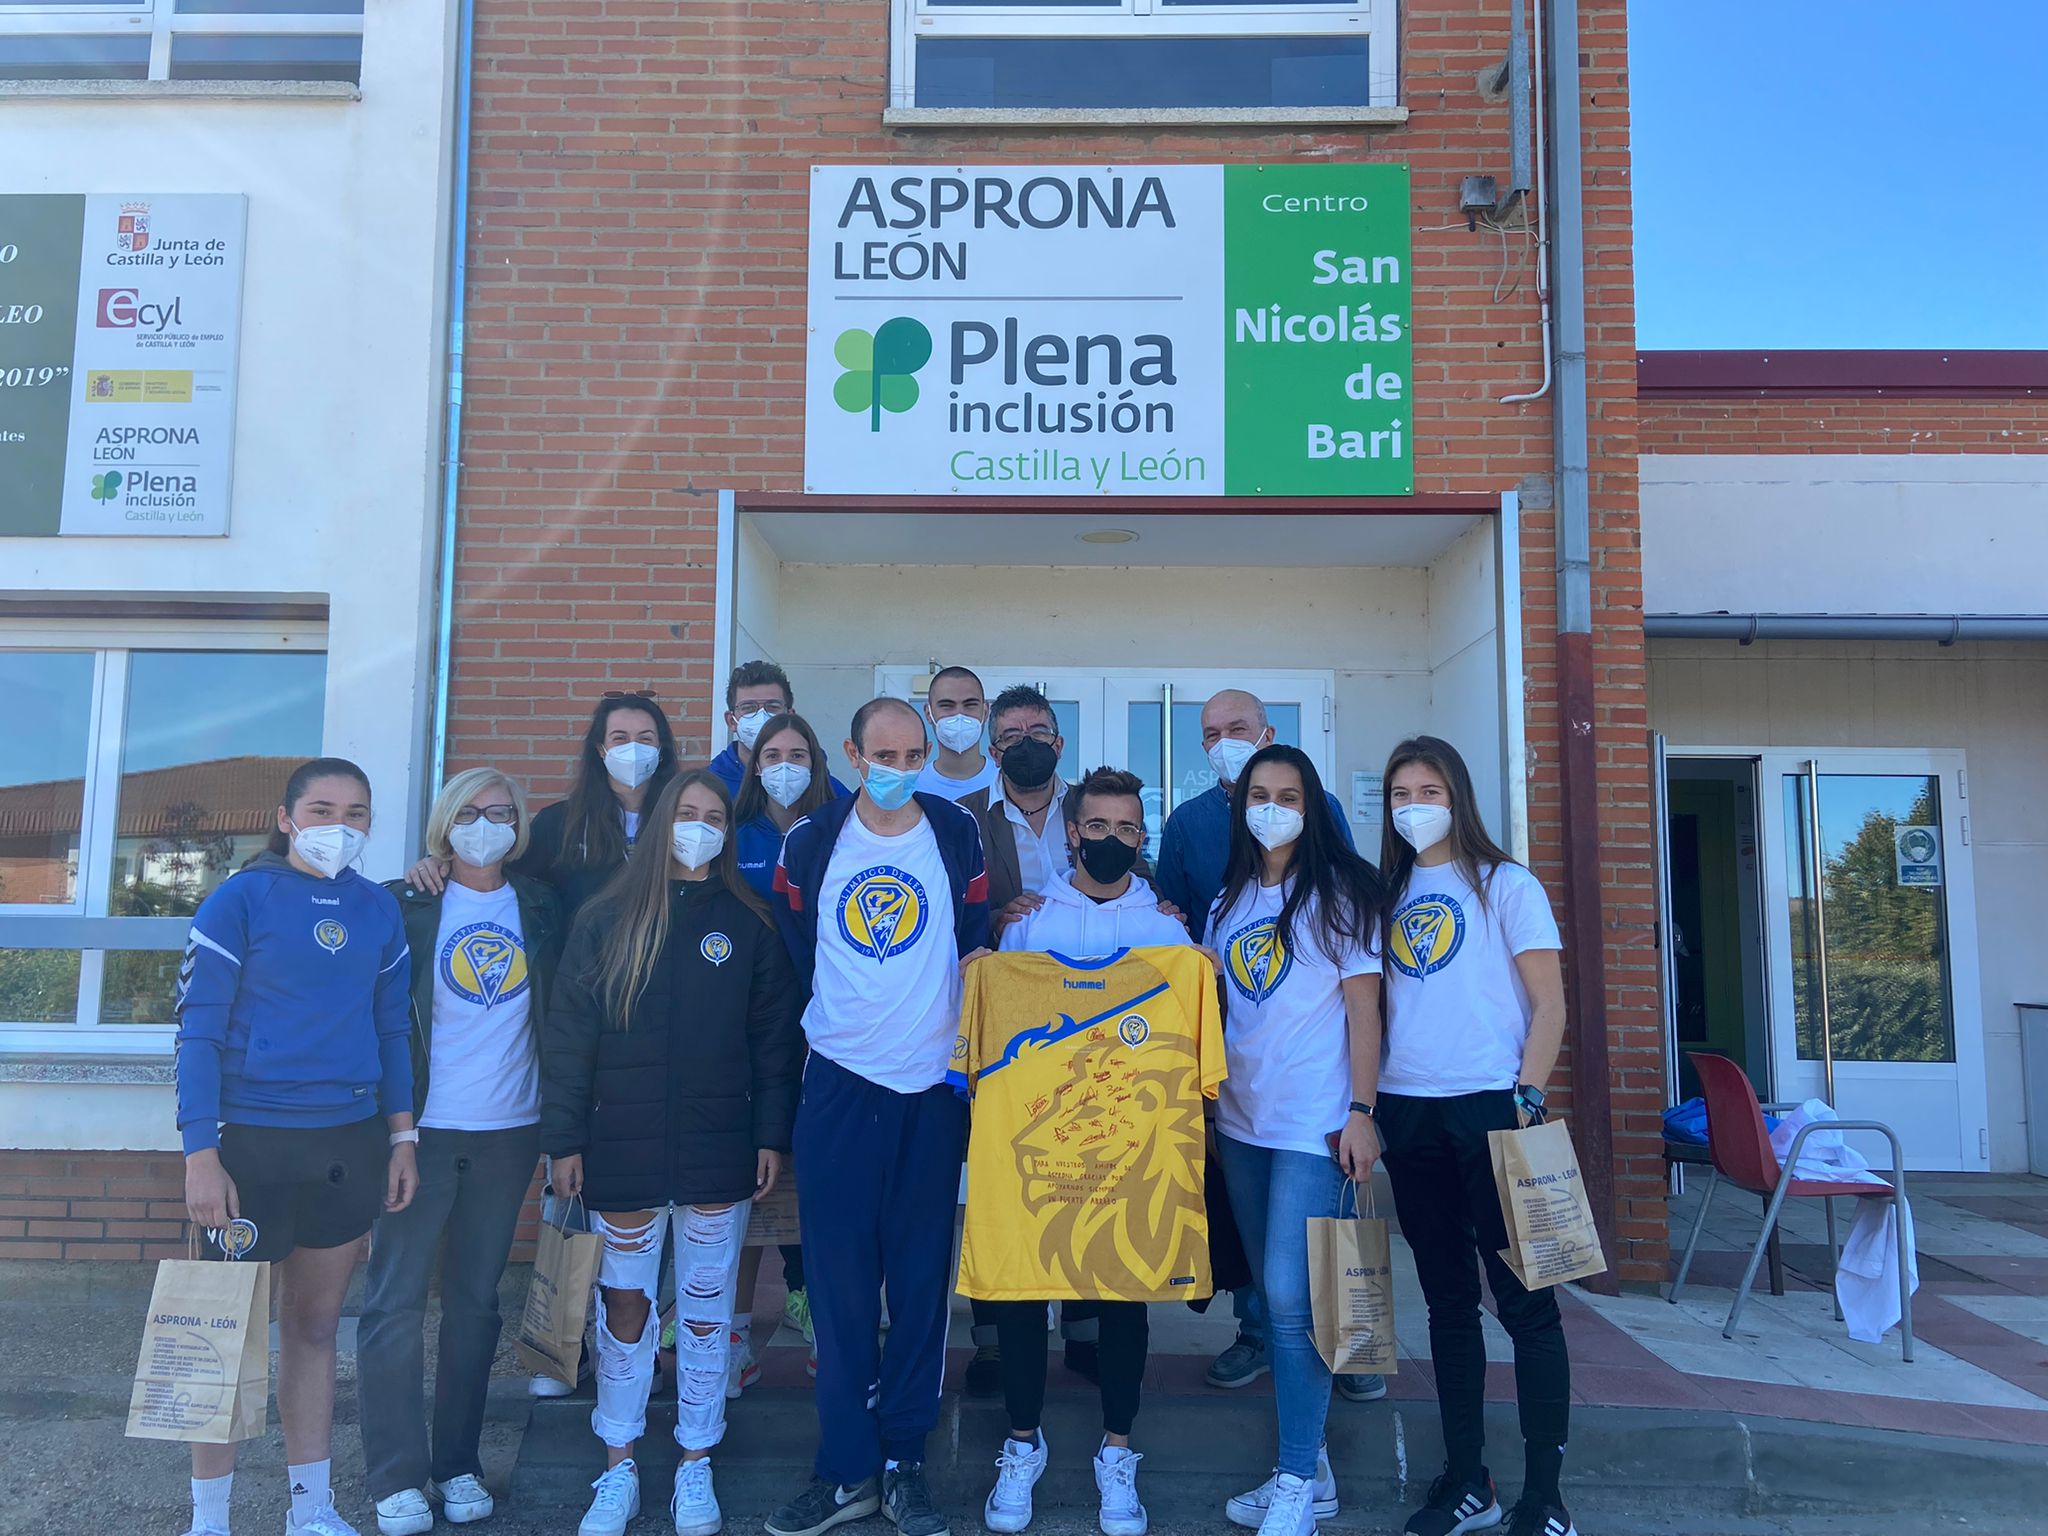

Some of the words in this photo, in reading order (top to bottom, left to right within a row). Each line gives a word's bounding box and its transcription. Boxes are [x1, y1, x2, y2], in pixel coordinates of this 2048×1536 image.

[837, 176, 1176, 229] ASPRONA
[1262, 193, 1368, 213] Centro
[153, 239, 199, 251] Junta
[205, 239, 225, 251] de
[107, 253, 164, 266] Castilla
[168, 255, 179, 269] y
[184, 253, 224, 266] León
[834, 232, 967, 281] LEÓN
[1312, 250, 1401, 284] San
[1235, 302, 1402, 343] Nicolás
[136, 333, 164, 341] SERVICIO
[165, 332, 190, 341] PÚBLICO
[179, 340, 196, 348] LEÓN
[950, 317, 1177, 386] Plena
[1345, 363, 1402, 400] de
[949, 389, 1174, 434] inclusión
[0, 430, 26, 442] tes
[95, 427, 200, 444] ASPRONA
[1307, 417, 1402, 459] Bari
[93, 444, 135, 460] LEÓN
[950, 449, 1081, 481] Castilla
[1083, 455, 1111, 489] y
[1121, 448, 1206, 481] León
[126, 470, 197, 493] Plena
[125, 493, 196, 507] inclusión
[125, 510, 166, 521] Castilla
[168, 512, 175, 523] y
[177, 510, 204, 521] León
[838, 866, 886, 909] OLIMPICO
[891, 868, 905, 880] DE
[442, 922, 489, 959] OLIMPICO
[1226, 917, 1271, 951] OLIMPICO
[861, 947, 871, 956] 19
[1063, 977, 1106, 990] hummel
[1516, 1173, 1557, 1188] ASPRONA
[153, 1314, 201, 1327] ASPRONA
[210, 1315, 238, 1330] LEÓN
